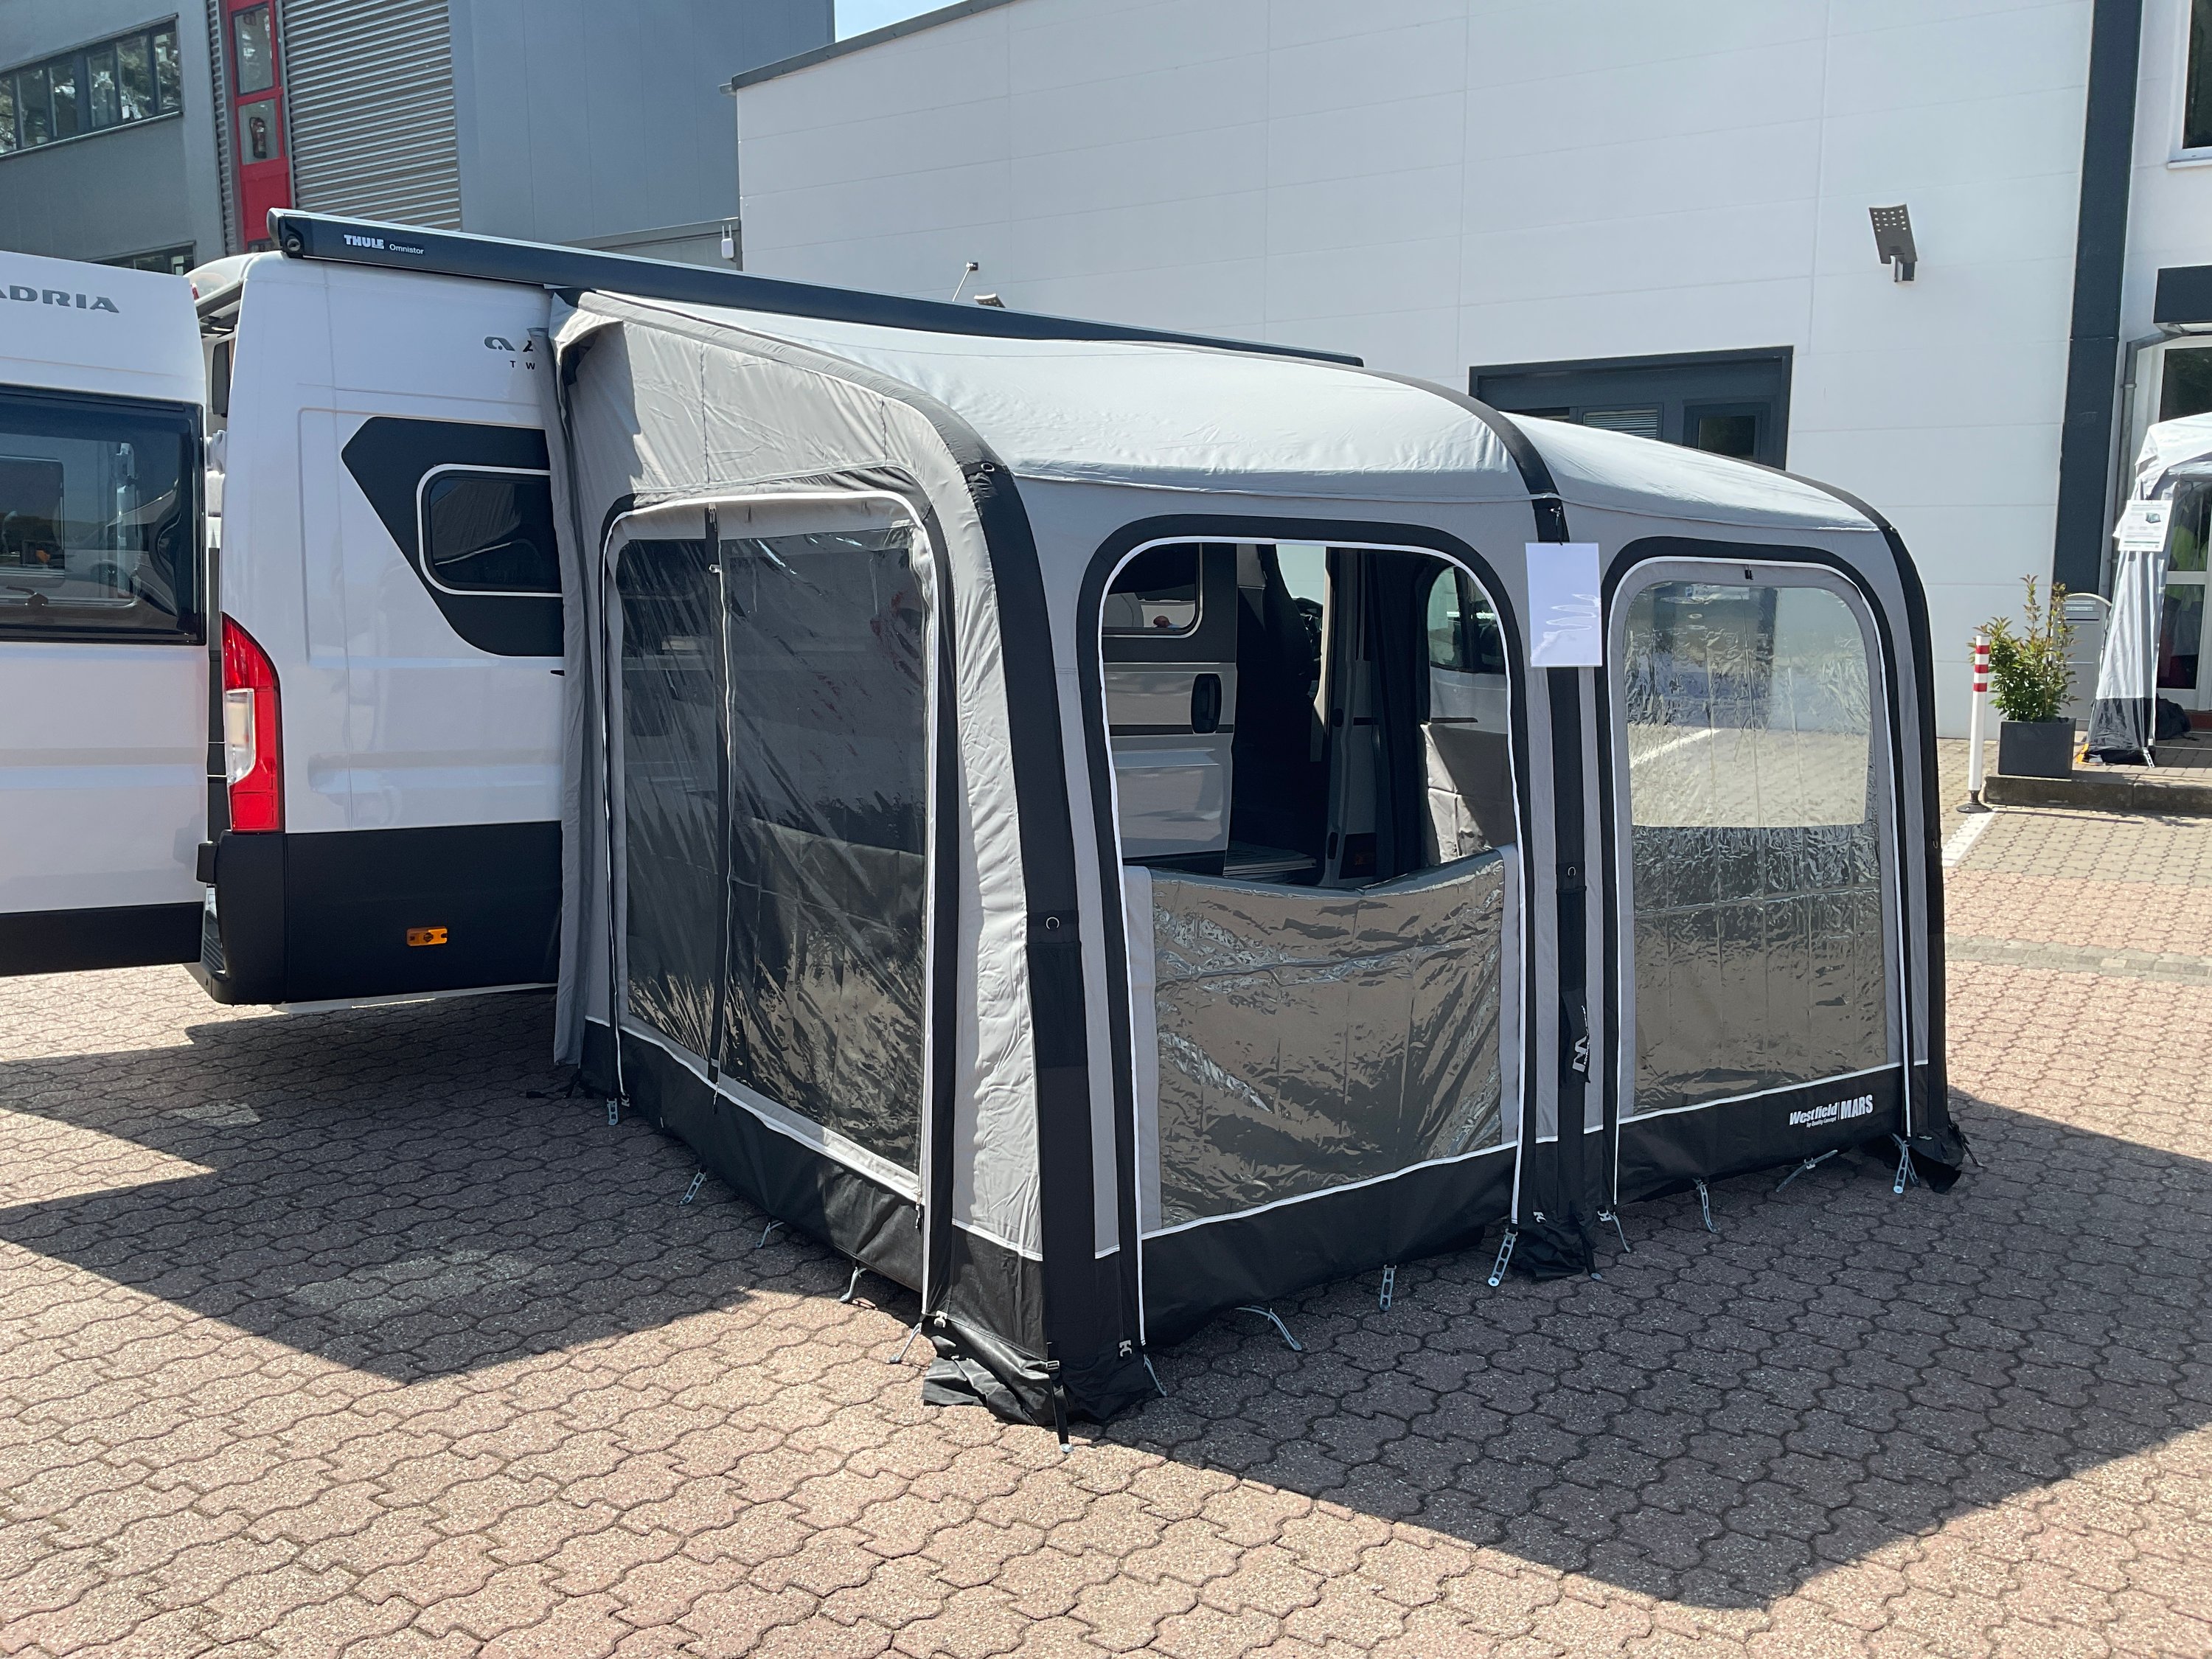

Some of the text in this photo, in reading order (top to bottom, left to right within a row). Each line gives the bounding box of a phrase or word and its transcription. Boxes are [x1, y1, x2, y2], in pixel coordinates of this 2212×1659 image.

[344, 234, 425, 254] THULE Omnistor
[0, 285, 119, 313] DRIA
[1790, 1094, 1874, 1125] Westfield MARS
